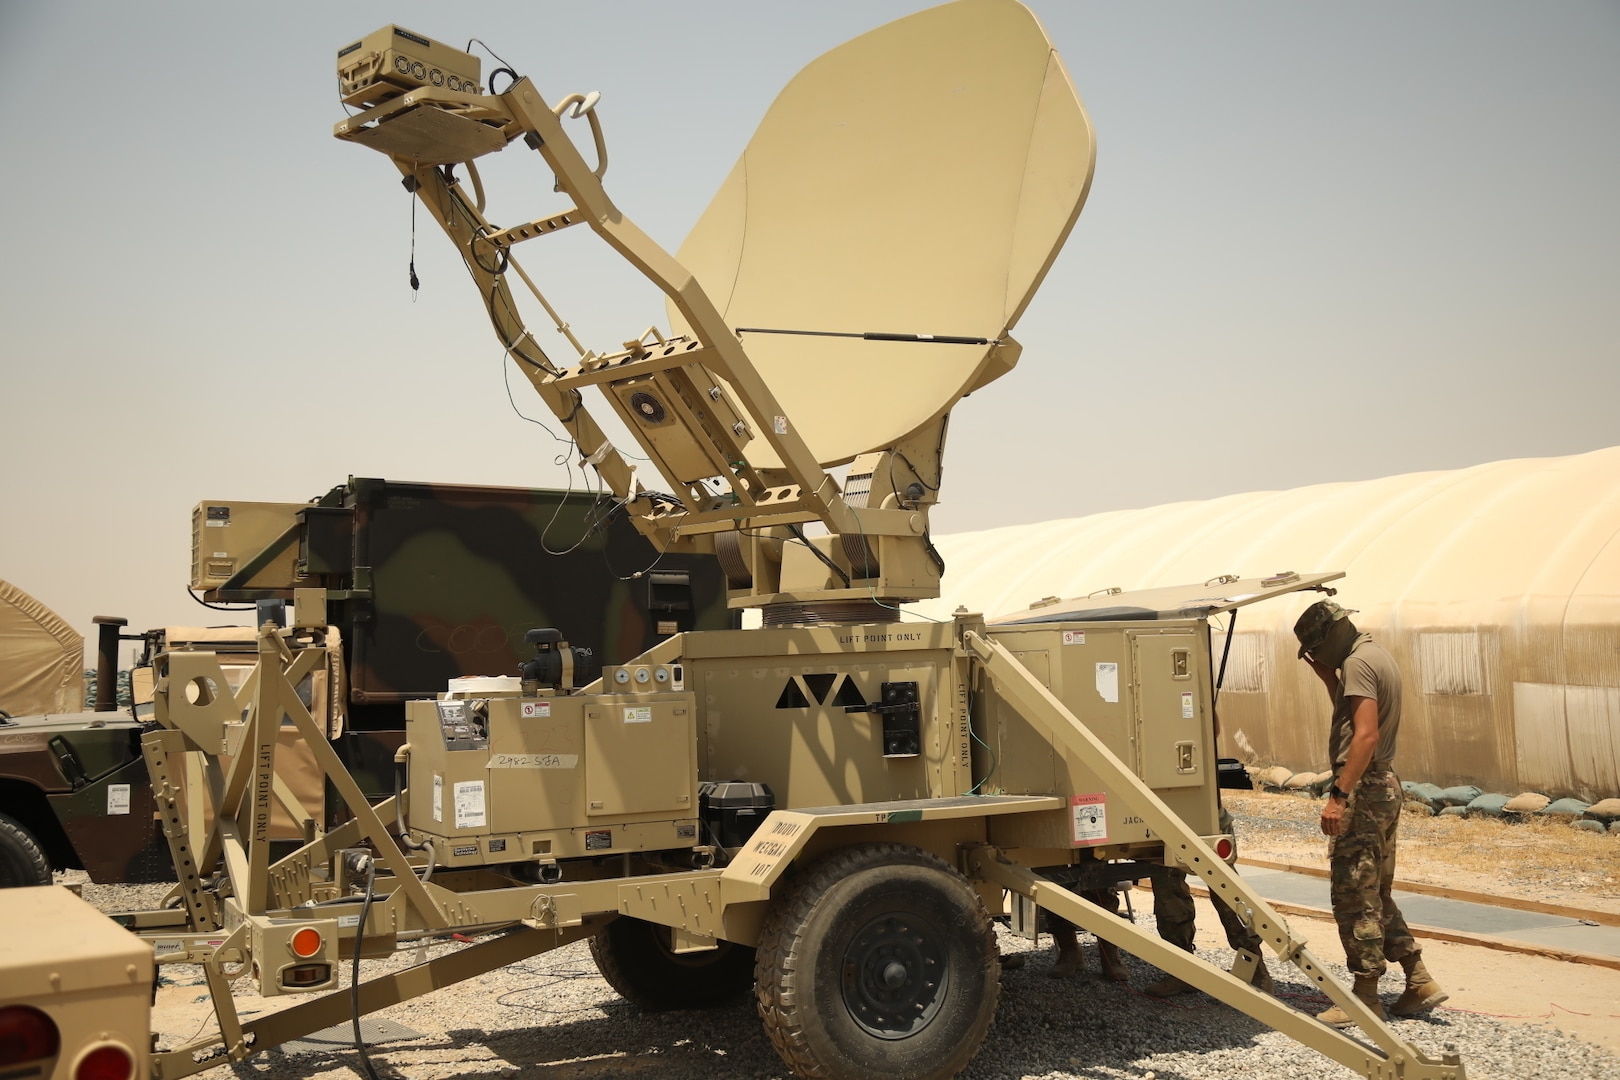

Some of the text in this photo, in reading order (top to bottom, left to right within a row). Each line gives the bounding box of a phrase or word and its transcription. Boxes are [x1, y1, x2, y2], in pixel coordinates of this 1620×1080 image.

[839, 632, 921, 644] LIFT POINT ONLY
[958, 683, 969, 768] LIFT POINT ONLY
[256, 744, 271, 842] LIFT POINT ONLY
